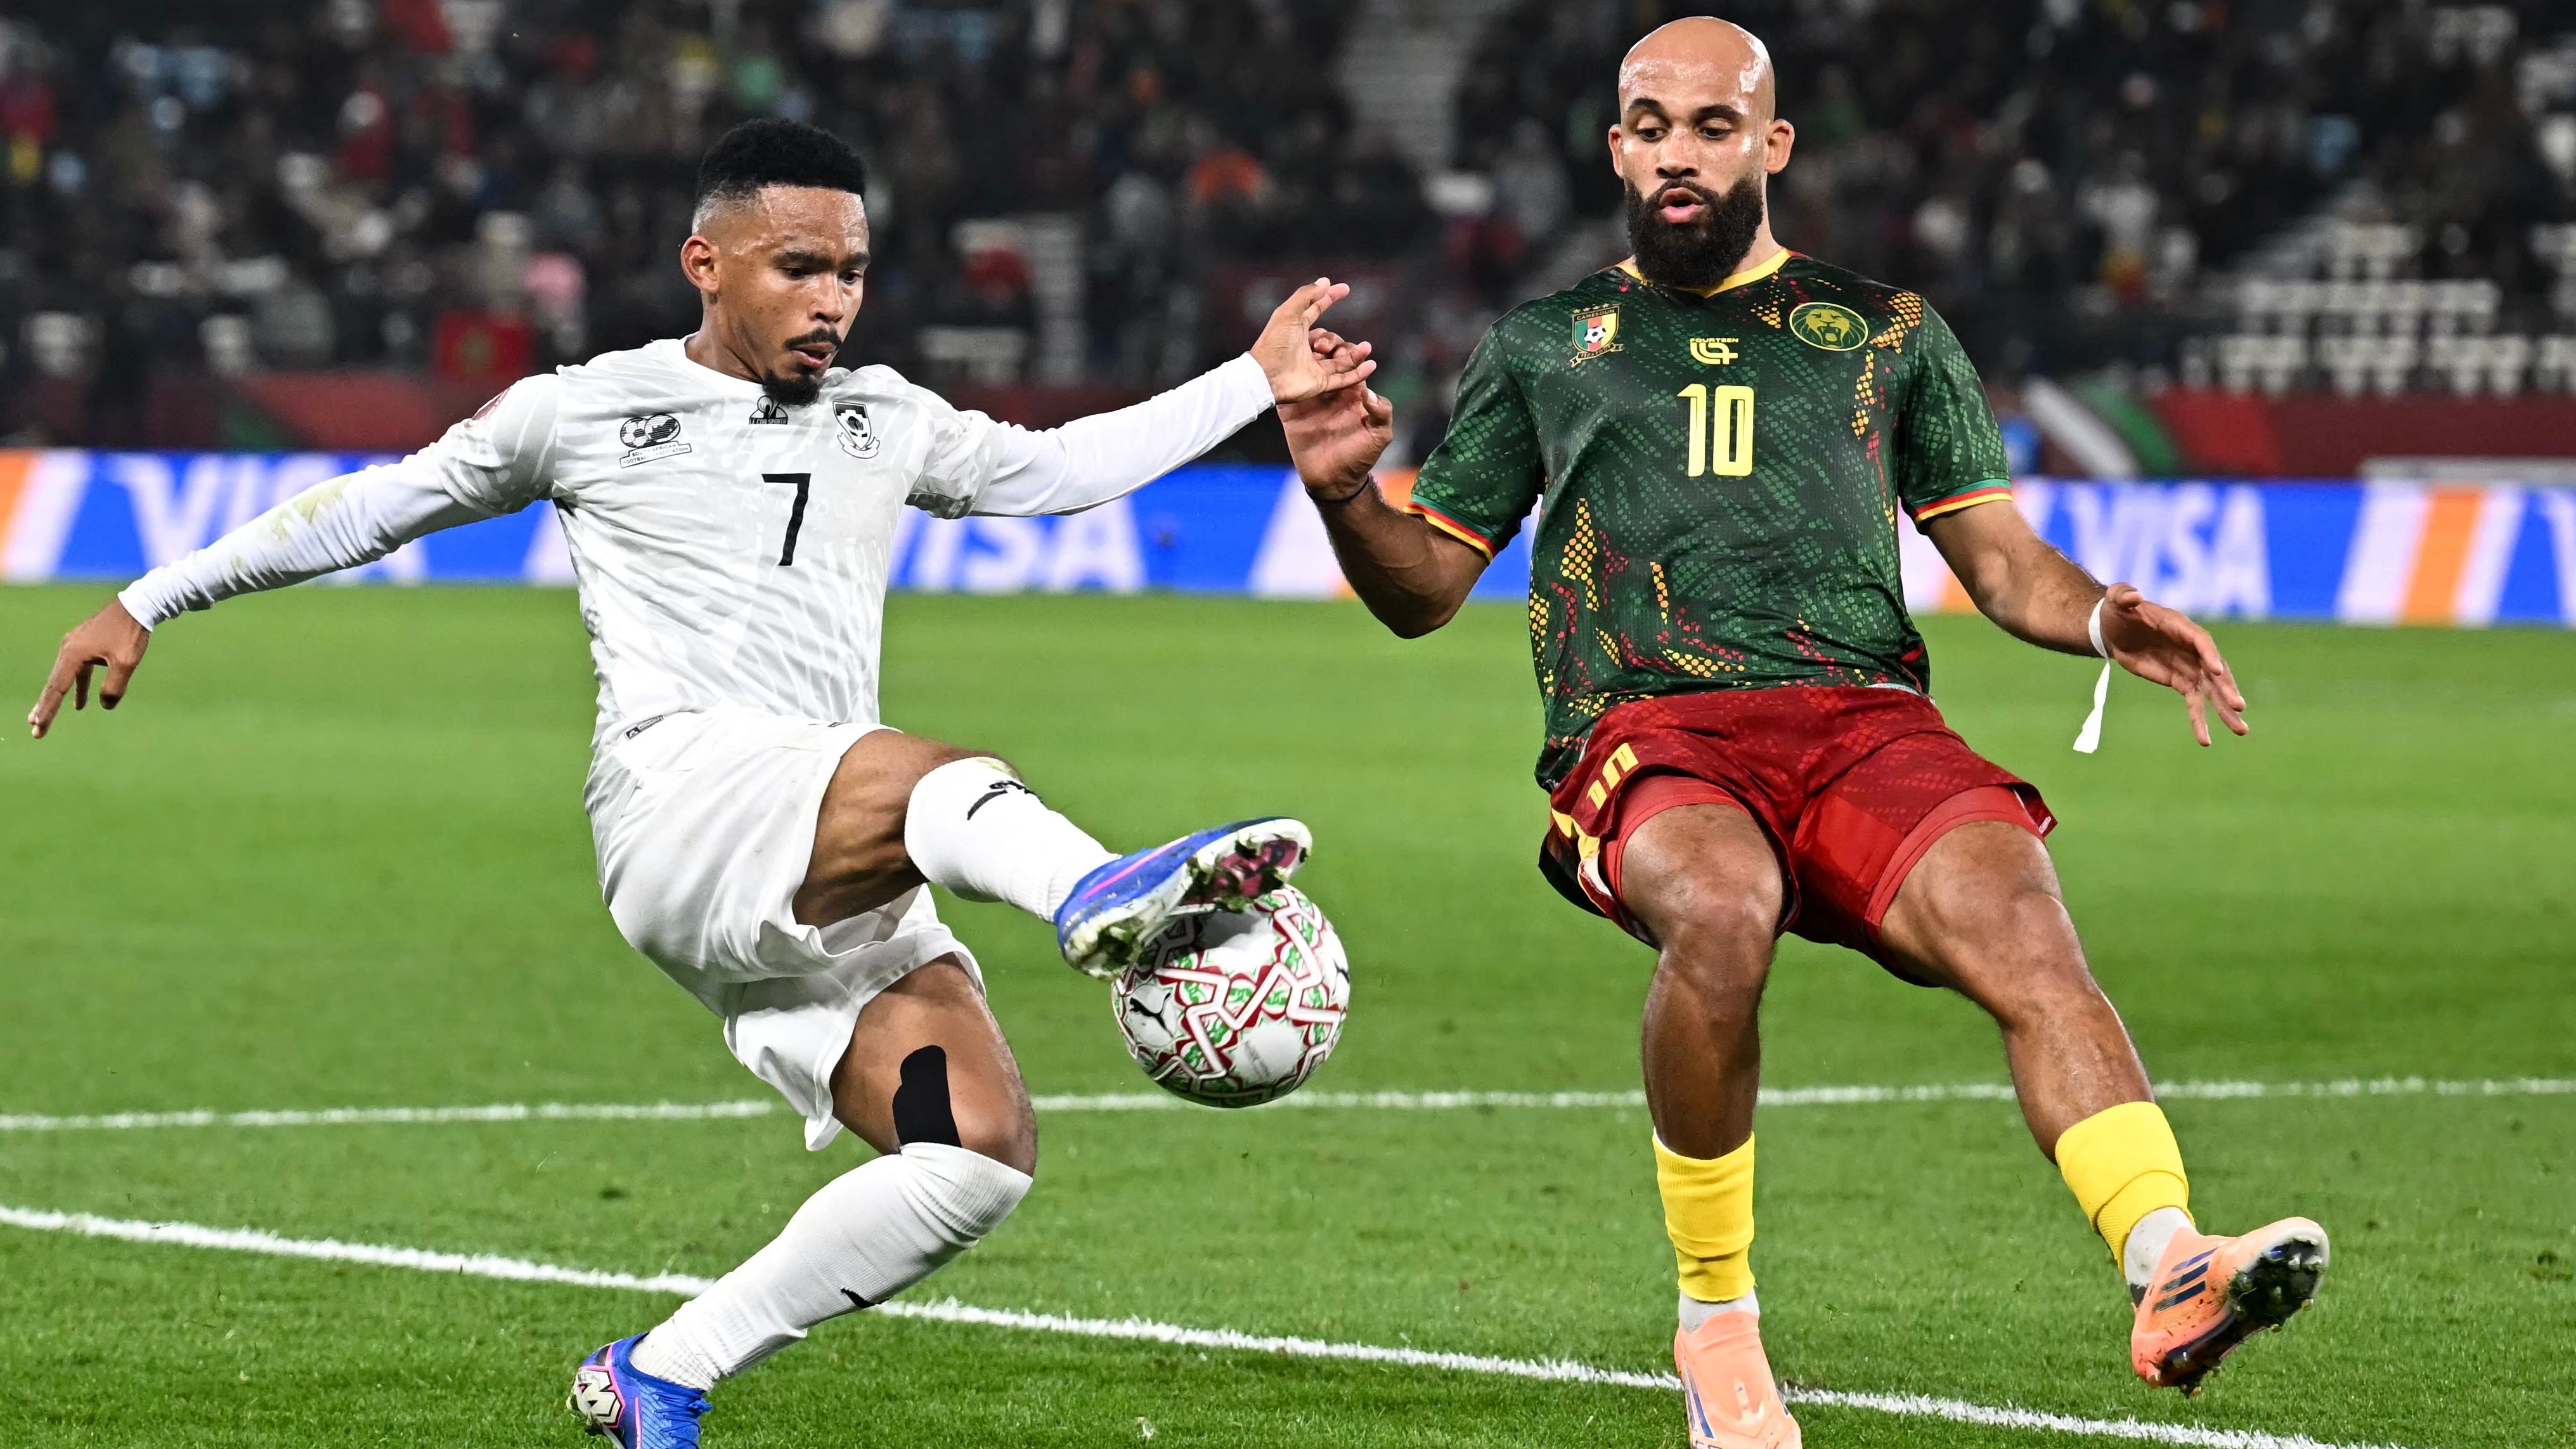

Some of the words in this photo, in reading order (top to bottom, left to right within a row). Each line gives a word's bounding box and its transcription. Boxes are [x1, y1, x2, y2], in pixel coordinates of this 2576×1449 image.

[1576, 308, 1615, 320] CAMEROUN
[623, 455, 650, 464] FOOTBAL
[631, 449, 650, 457] SOU
[1676, 383, 1755, 478] 10
[761, 473, 812, 566] 7
[2066, 482, 2273, 618] VISA
[1585, 743, 1639, 811] 10
